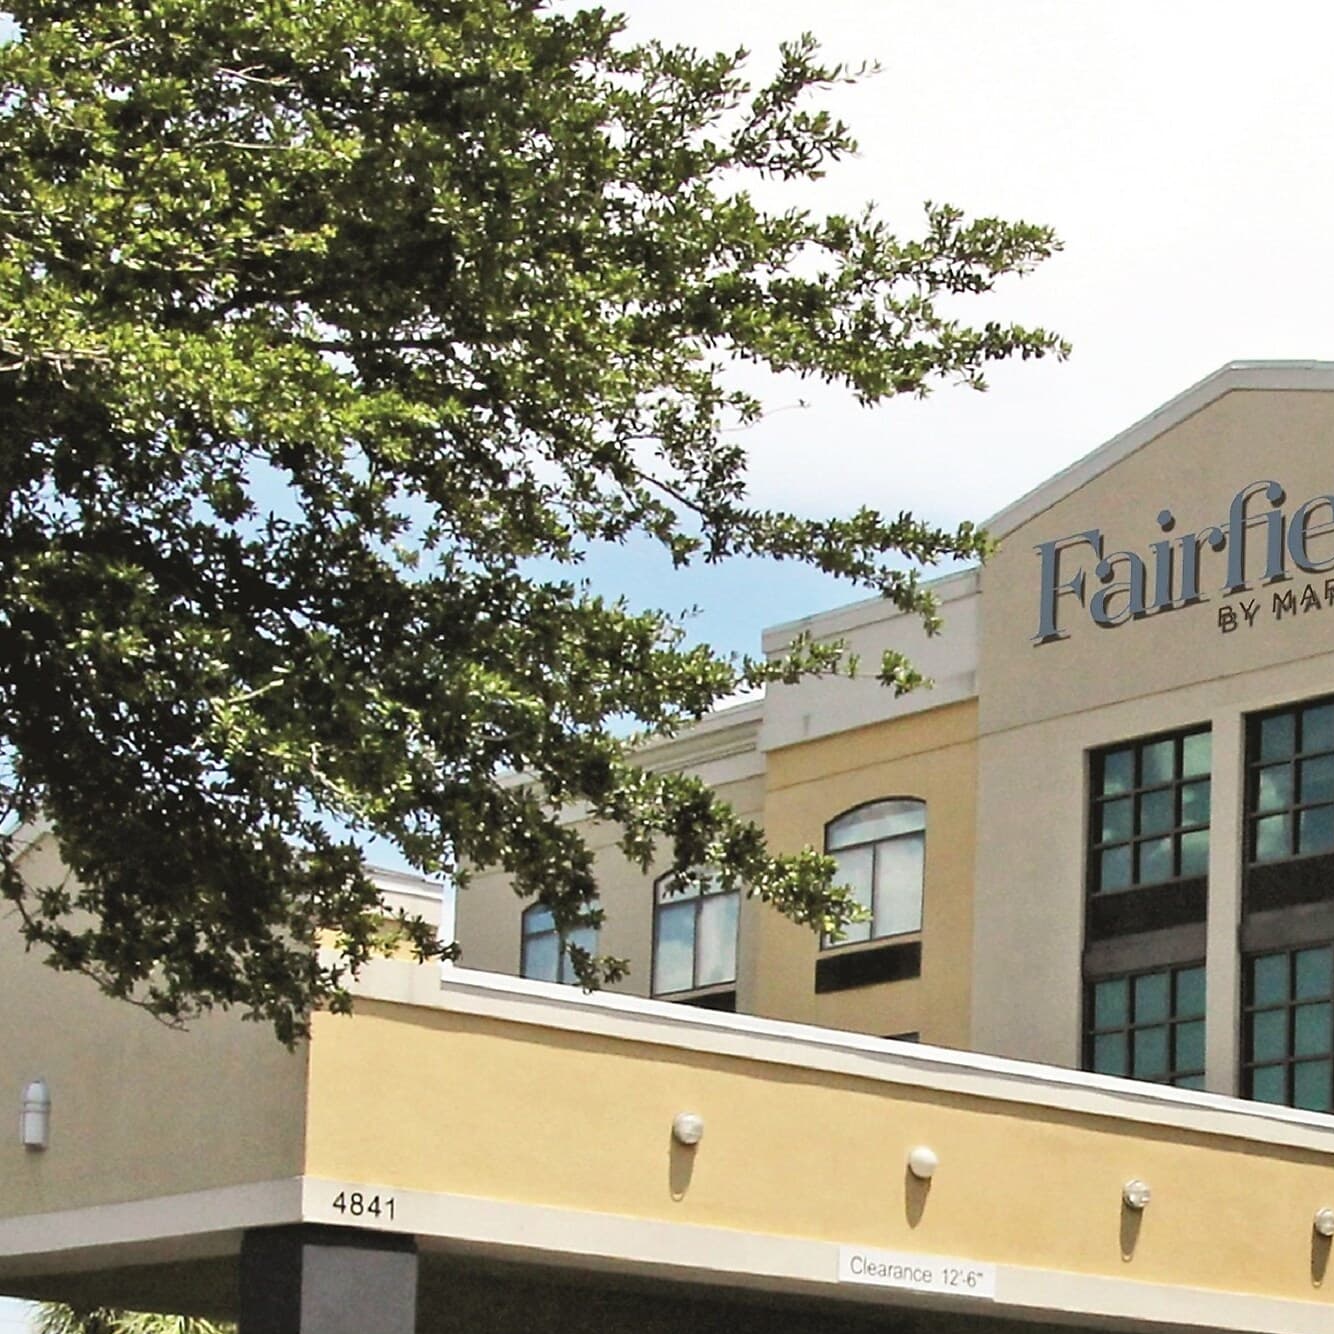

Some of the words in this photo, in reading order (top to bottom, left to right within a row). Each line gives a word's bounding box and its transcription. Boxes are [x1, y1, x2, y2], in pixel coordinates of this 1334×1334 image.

[1218, 600, 1258, 632] BY
[332, 1191, 396, 1220] 4841
[850, 1255, 932, 1284] Clearance
